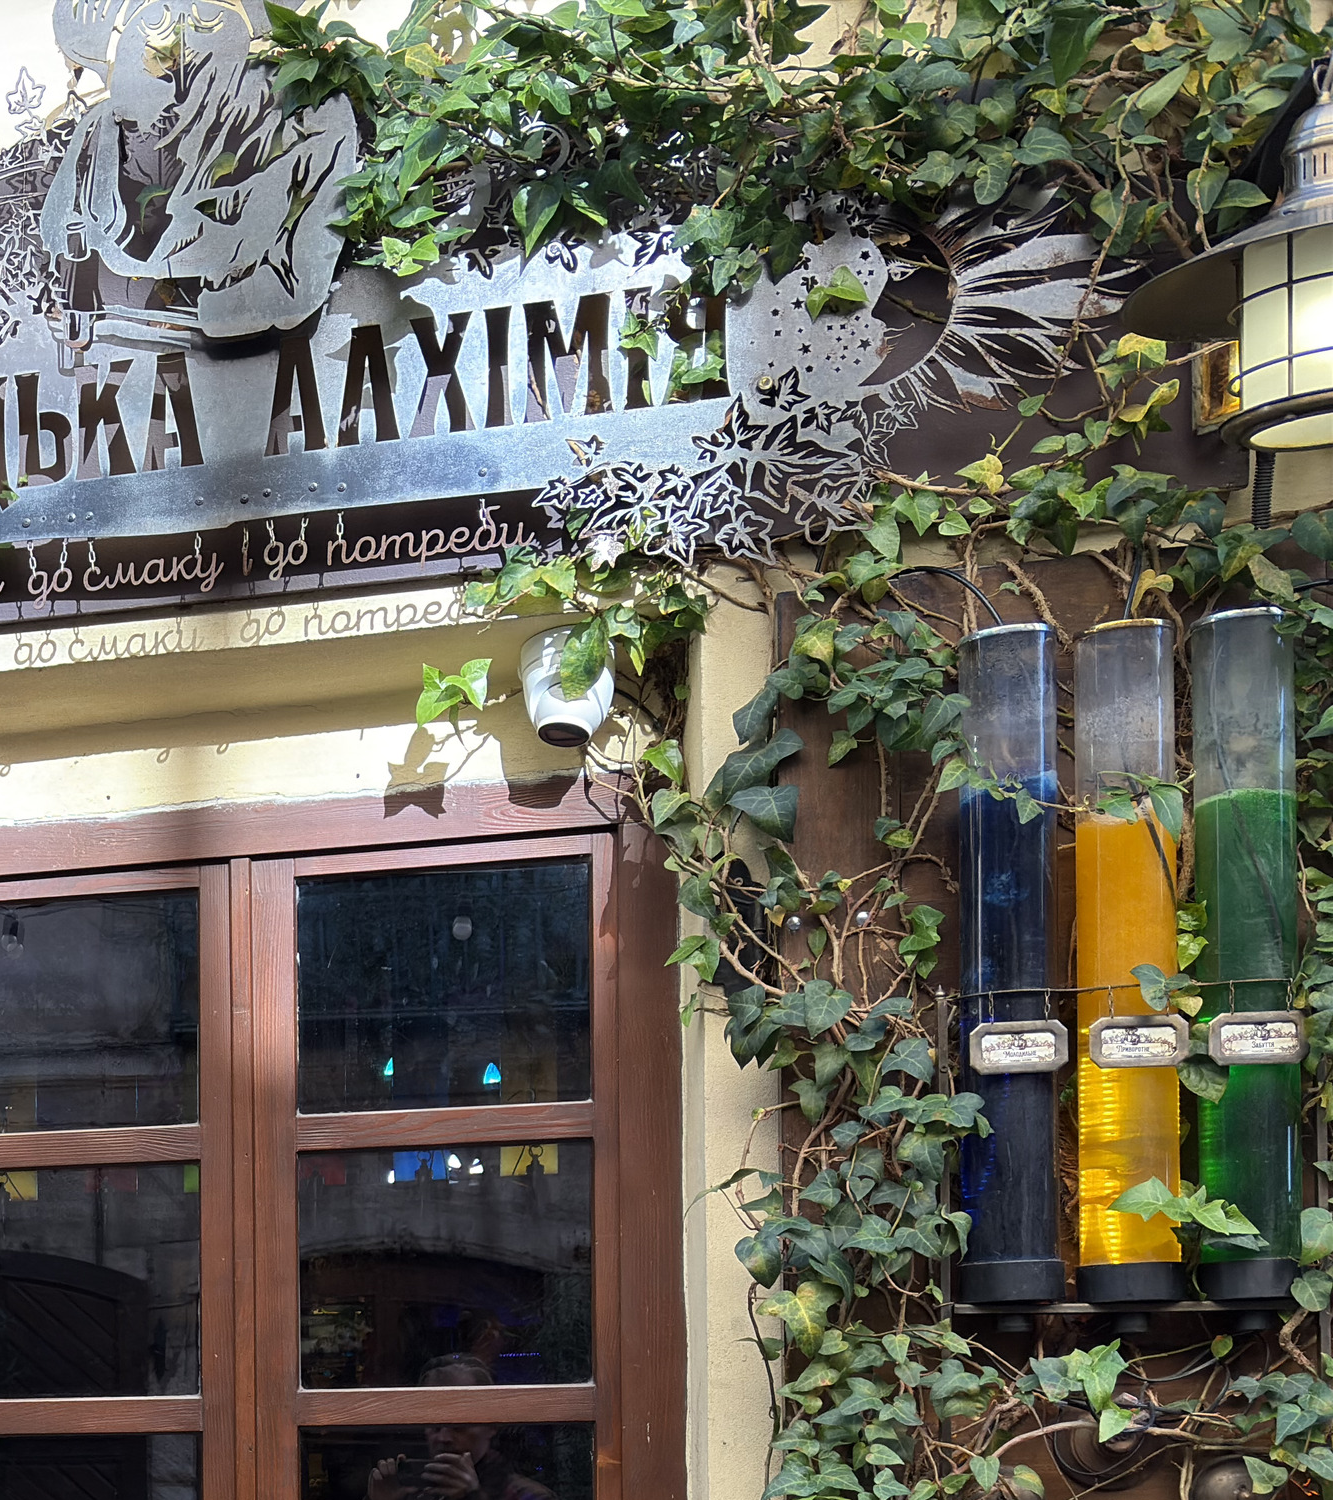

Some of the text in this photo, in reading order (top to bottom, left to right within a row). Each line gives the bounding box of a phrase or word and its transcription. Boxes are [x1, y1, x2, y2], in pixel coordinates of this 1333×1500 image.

[27, 567, 73, 610] до
[83, 552, 224, 593] смаку
[263, 538, 309, 581] до
[326, 505, 536, 571] потреби
